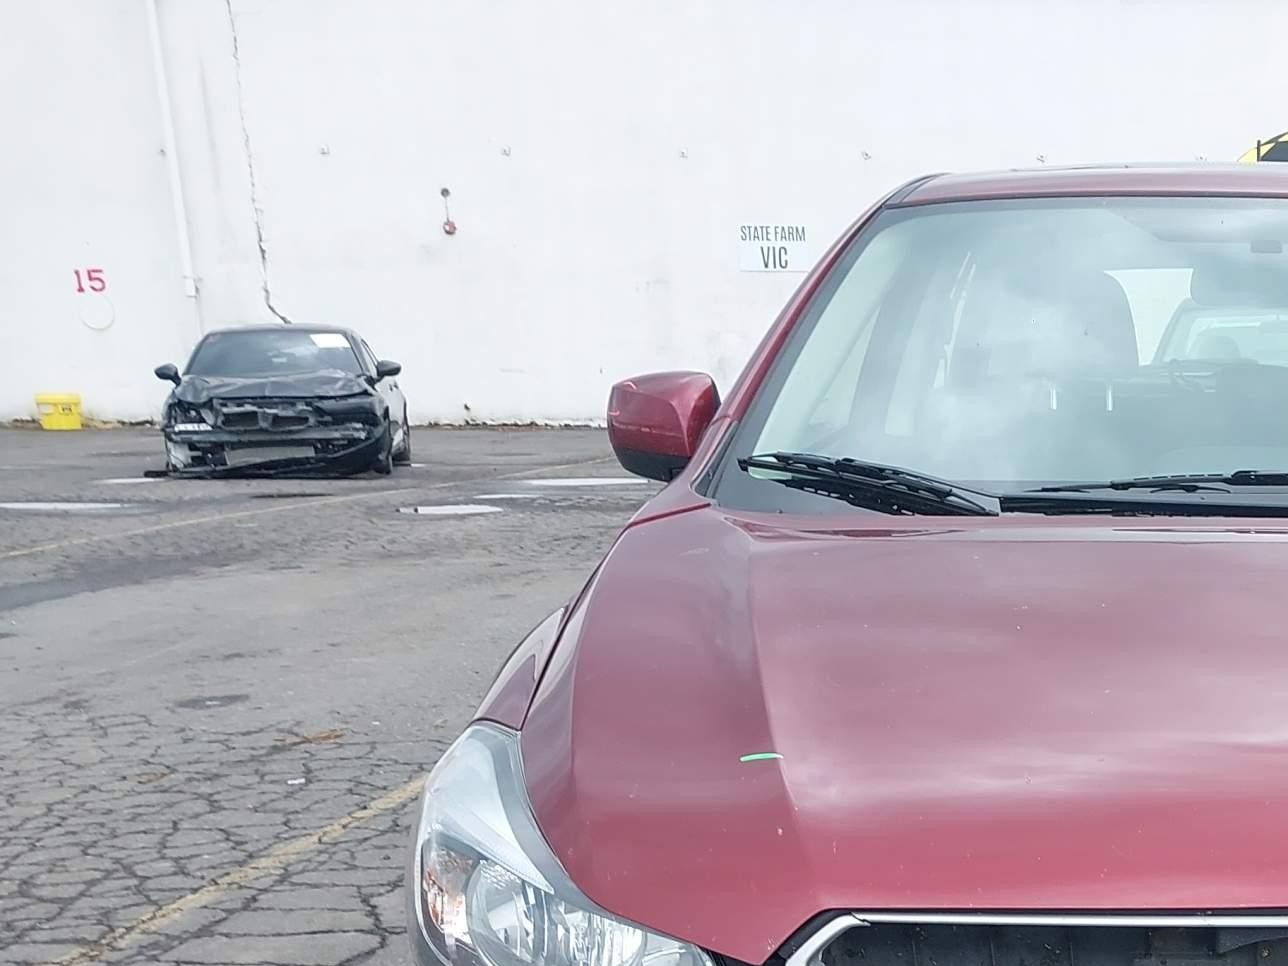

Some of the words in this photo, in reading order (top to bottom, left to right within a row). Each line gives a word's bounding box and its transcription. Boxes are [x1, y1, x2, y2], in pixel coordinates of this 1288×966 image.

[740, 225, 772, 241] STATE
[774, 225, 806, 241] FARM
[760, 246, 788, 269] VIC
[74, 269, 106, 293] 15
